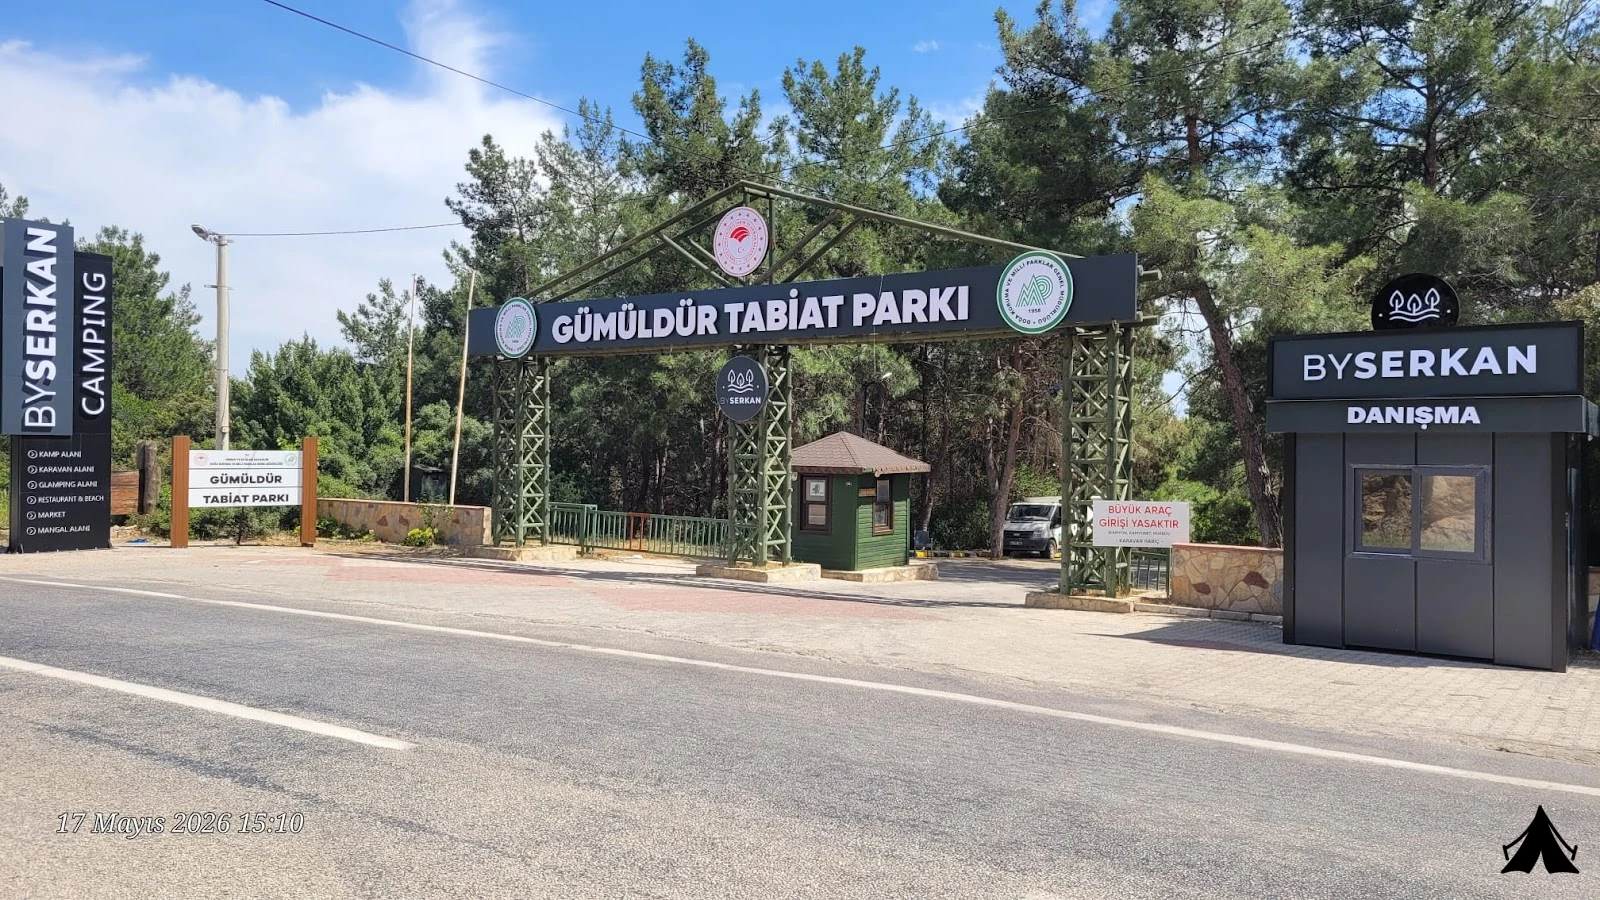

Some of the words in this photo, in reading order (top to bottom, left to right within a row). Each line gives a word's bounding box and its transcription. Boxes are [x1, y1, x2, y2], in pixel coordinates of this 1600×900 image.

[1026, 259, 1054, 269] PARKLAR
[551, 298, 718, 344] GÜMÜLDÜR
[724, 288, 844, 334] TABİAT
[852, 285, 969, 327] PARKI
[24, 227, 57, 427] BYSERKAN
[82, 272, 106, 415] CAMPING
[1303, 345, 1537, 381] BYSERKAN
[1347, 406, 1481, 430] DANIŞMA
[210, 472, 282, 484] GÜMÜLDÜR
[203, 492, 249, 504] TABİAT
[252, 494, 288, 502] PARKI
[1108, 504, 1142, 514] BÜYÜK
[1144, 506, 1172, 517] ARAÇ
[1099, 517, 1128, 529] GİRİŞİ
[1132, 520, 1179, 528] YASAKTIR
